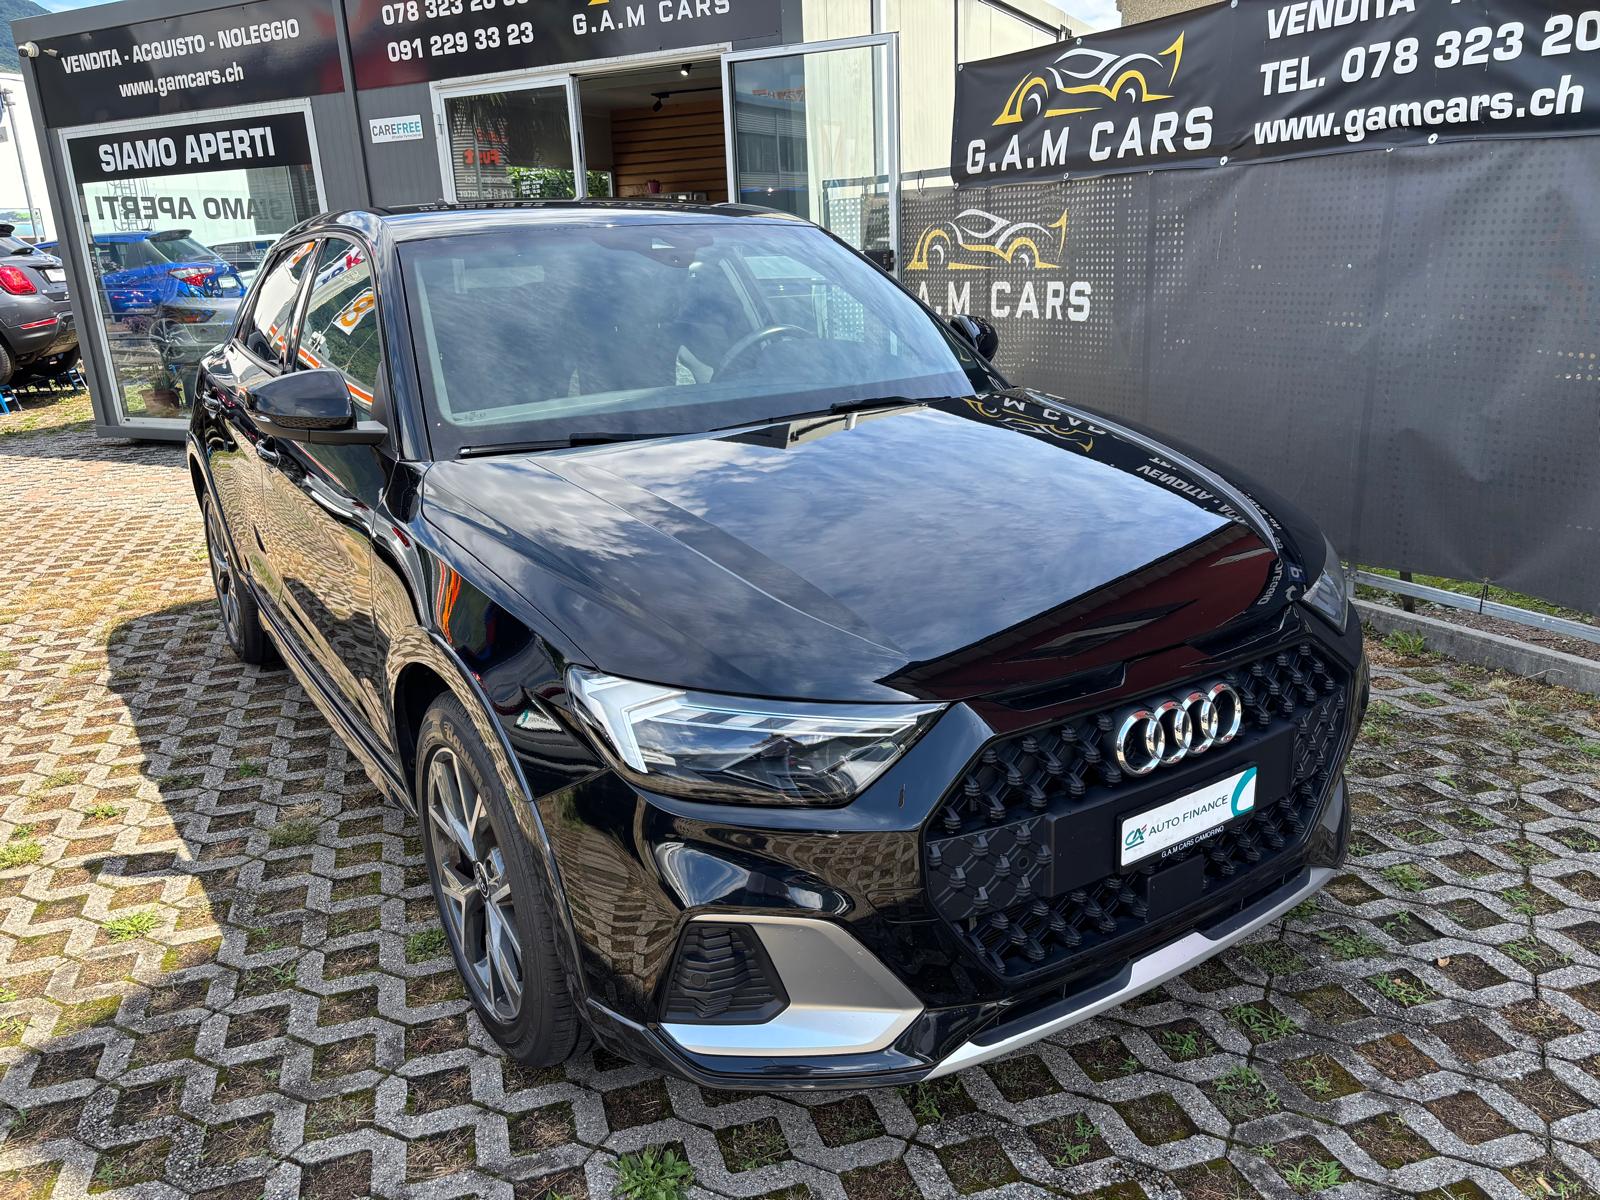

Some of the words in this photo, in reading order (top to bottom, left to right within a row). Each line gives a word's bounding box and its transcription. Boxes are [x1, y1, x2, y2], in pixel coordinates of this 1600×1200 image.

[381, 0, 419, 26] 078
[424, 0, 463, 19] 323
[572, 4, 646, 36] G.A.M
[658, 0, 730, 23] CARS
[61, 49, 122, 75] VENDITA
[133, 34, 206, 63] ACQUISTO
[218, 18, 300, 48] NOLEGGIO
[387, 38, 424, 62] 091
[429, 31, 469, 57] 229
[474, 26, 501, 50] 33
[506, 21, 534, 46] 23
[1260, 57, 1325, 96] TEL.
[1340, 38, 1419, 83] 078
[1434, 22, 1525, 69] 323
[1541, 11, 1600, 57] 20
[119, 61, 244, 98] www.gamcars.ch
[372, 120, 421, 137] CAREFREE
[1254, 74, 1584, 145] www.gamcars.ch
[98, 138, 177, 172] SIAMO
[185, 126, 276, 165] APERTI
[966, 126, 1070, 175] G.A.M
[1088, 106, 1214, 162] CARS
[917, 281, 971, 316] A.M
[990, 281, 1092, 322] CARS
[1148, 816, 1180, 836] AUTO
[1182, 794, 1229, 822] FINANCE
[1178, 838, 1195, 851] CARS
[1195, 825, 1225, 844] CAMORINO
